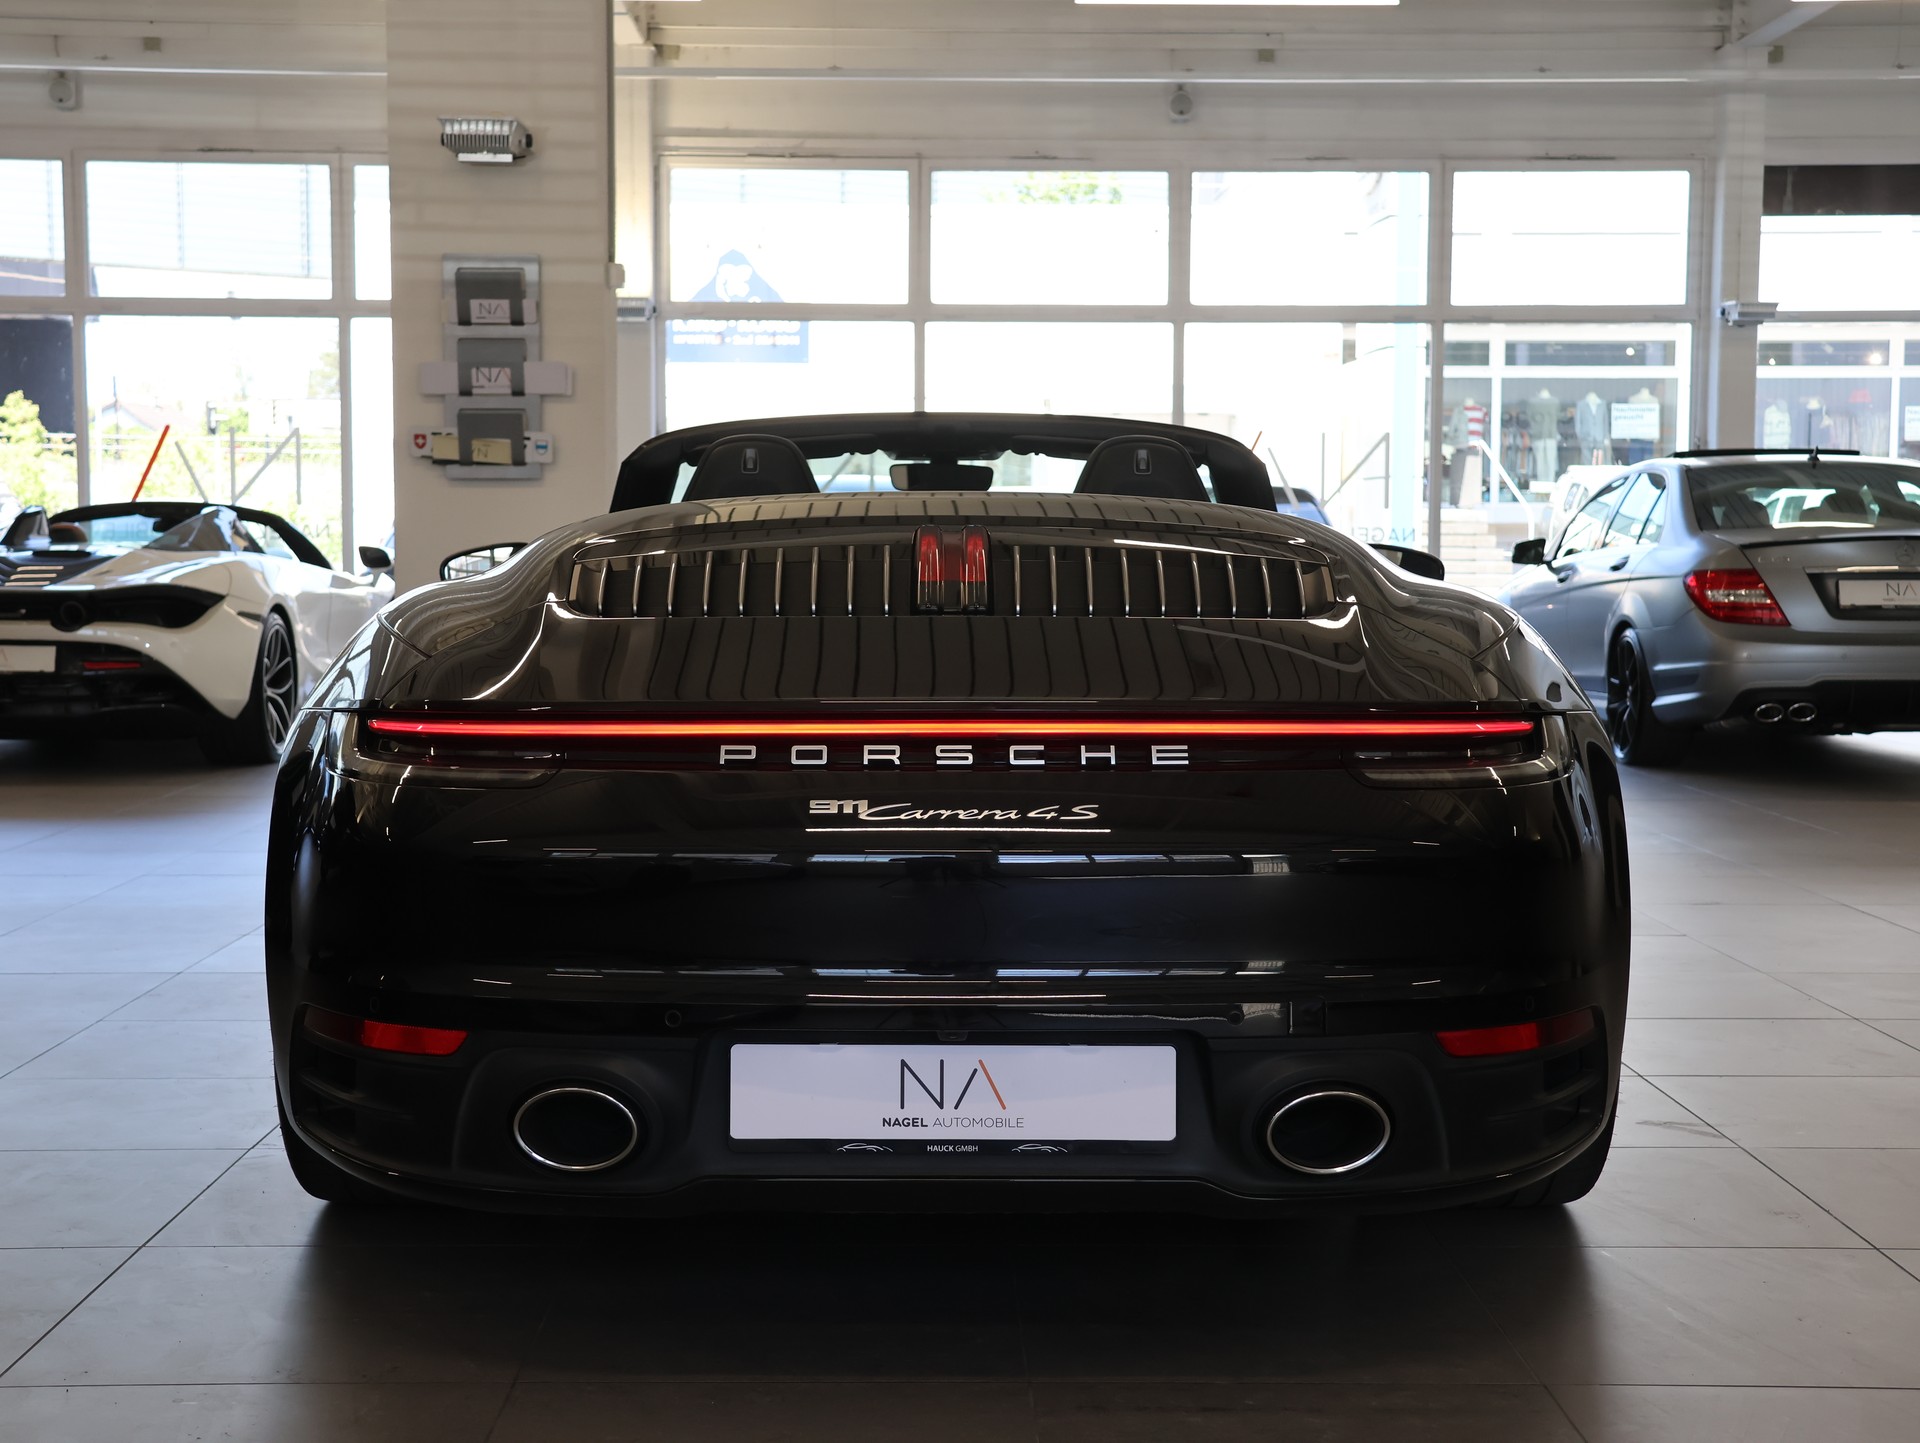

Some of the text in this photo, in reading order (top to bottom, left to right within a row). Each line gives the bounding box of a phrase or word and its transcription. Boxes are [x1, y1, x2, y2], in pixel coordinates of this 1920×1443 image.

[479, 302, 506, 315] NA
[475, 365, 512, 383] NA
[1885, 582, 1917, 596] NA
[719, 744, 1190, 766] PORSCHE
[808, 799, 868, 814] 911
[858, 801, 1022, 821] Carrera
[900, 1058, 1007, 1110] NA
[882, 1117, 1025, 1128] NAGEL AUTOMOBILE
[927, 1144, 979, 1153] HAUCK GMBH
